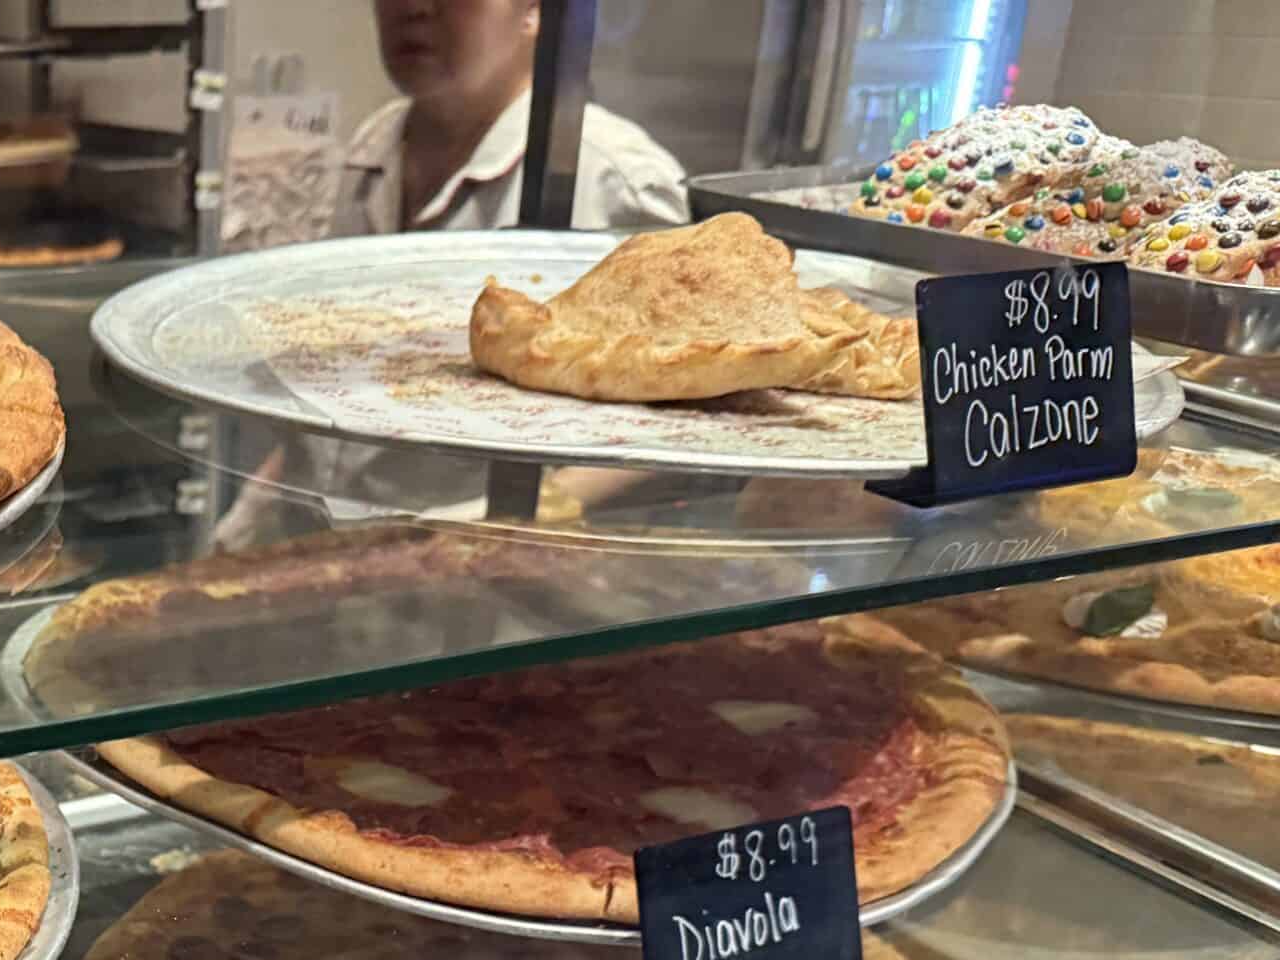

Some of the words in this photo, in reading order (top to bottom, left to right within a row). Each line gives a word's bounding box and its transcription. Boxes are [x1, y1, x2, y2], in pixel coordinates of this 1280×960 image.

[1004, 268, 1100, 333] $8.99
[933, 342, 1036, 405] Chicken
[1045, 335, 1113, 381] Parm
[965, 394, 1099, 467] Calzone
[715, 816, 818, 882] $8.99
